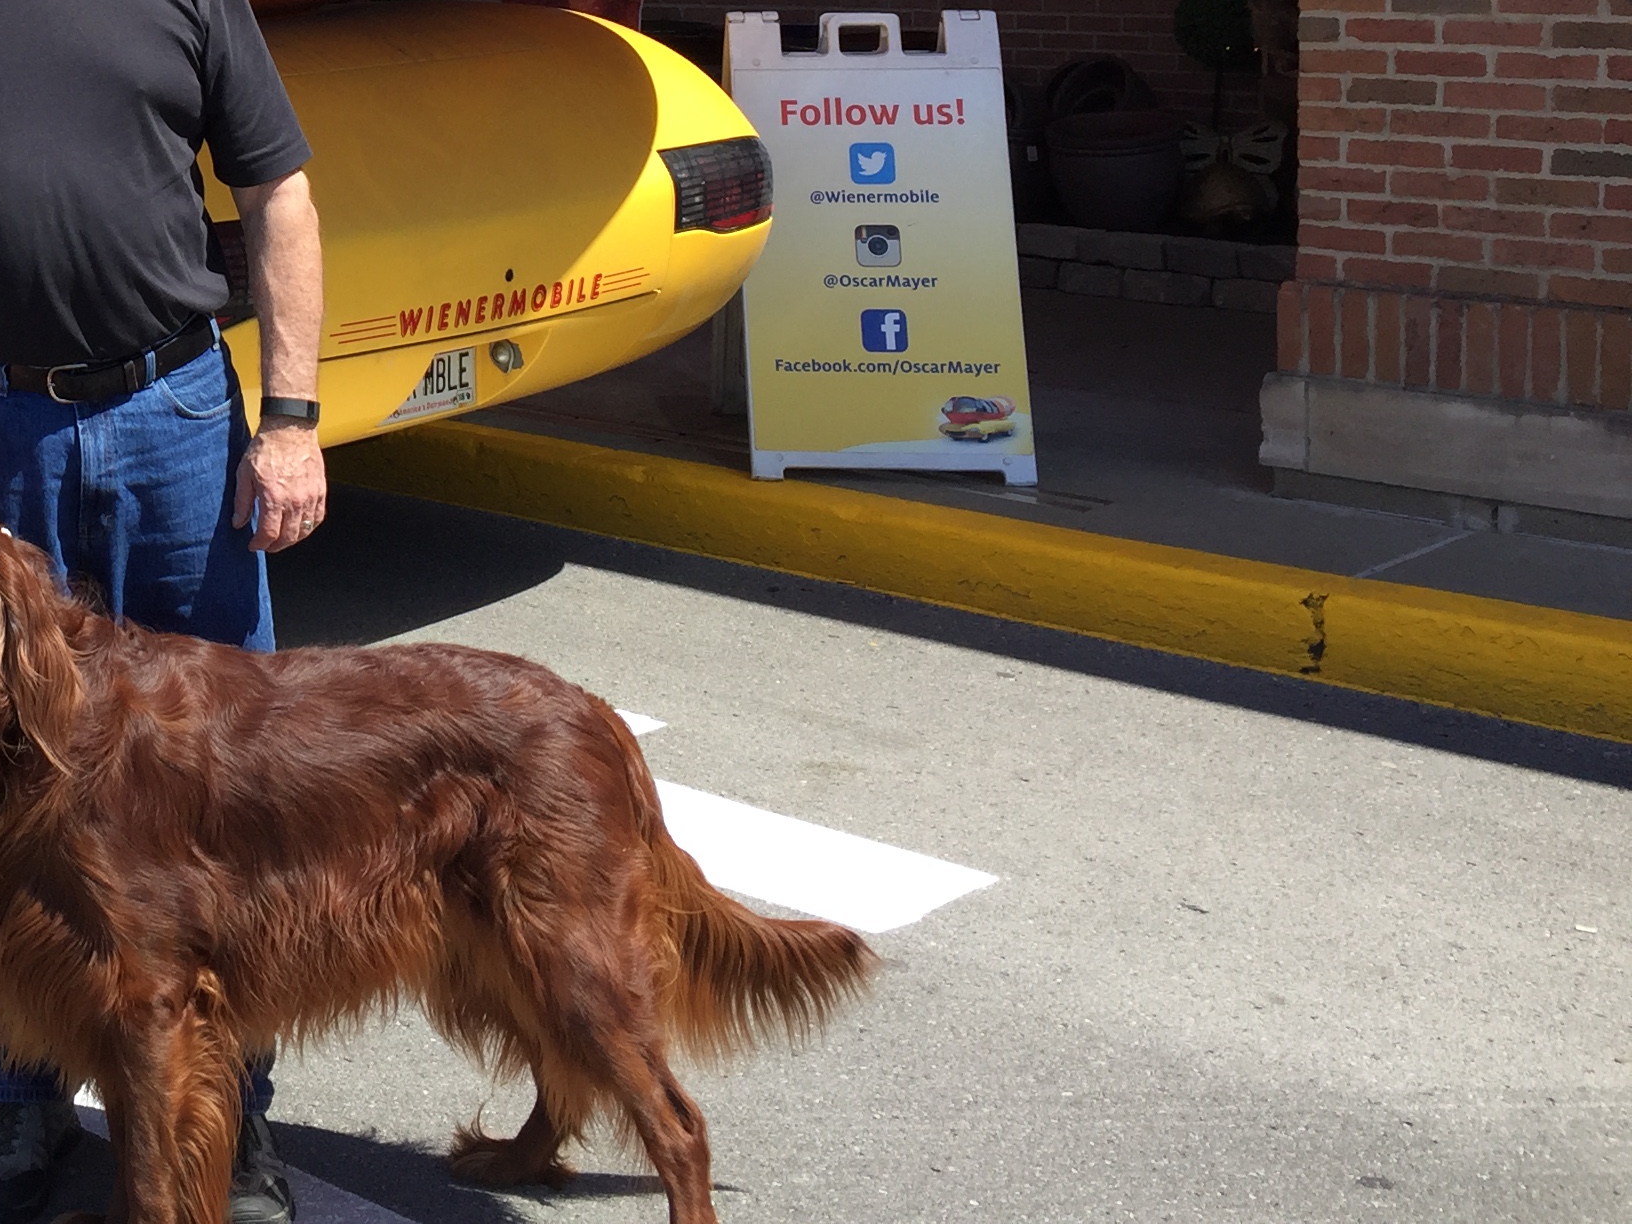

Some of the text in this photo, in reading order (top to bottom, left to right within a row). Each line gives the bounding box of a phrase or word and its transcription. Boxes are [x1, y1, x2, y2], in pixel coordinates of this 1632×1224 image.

[780, 97, 966, 126] Follow us!
[810, 189, 940, 205] @Wienermobile
[823, 274, 938, 291] @OscarMayer
[400, 273, 602, 338] WIENERMOBILE
[775, 359, 1001, 377] Facebook.com/OscarMayer
